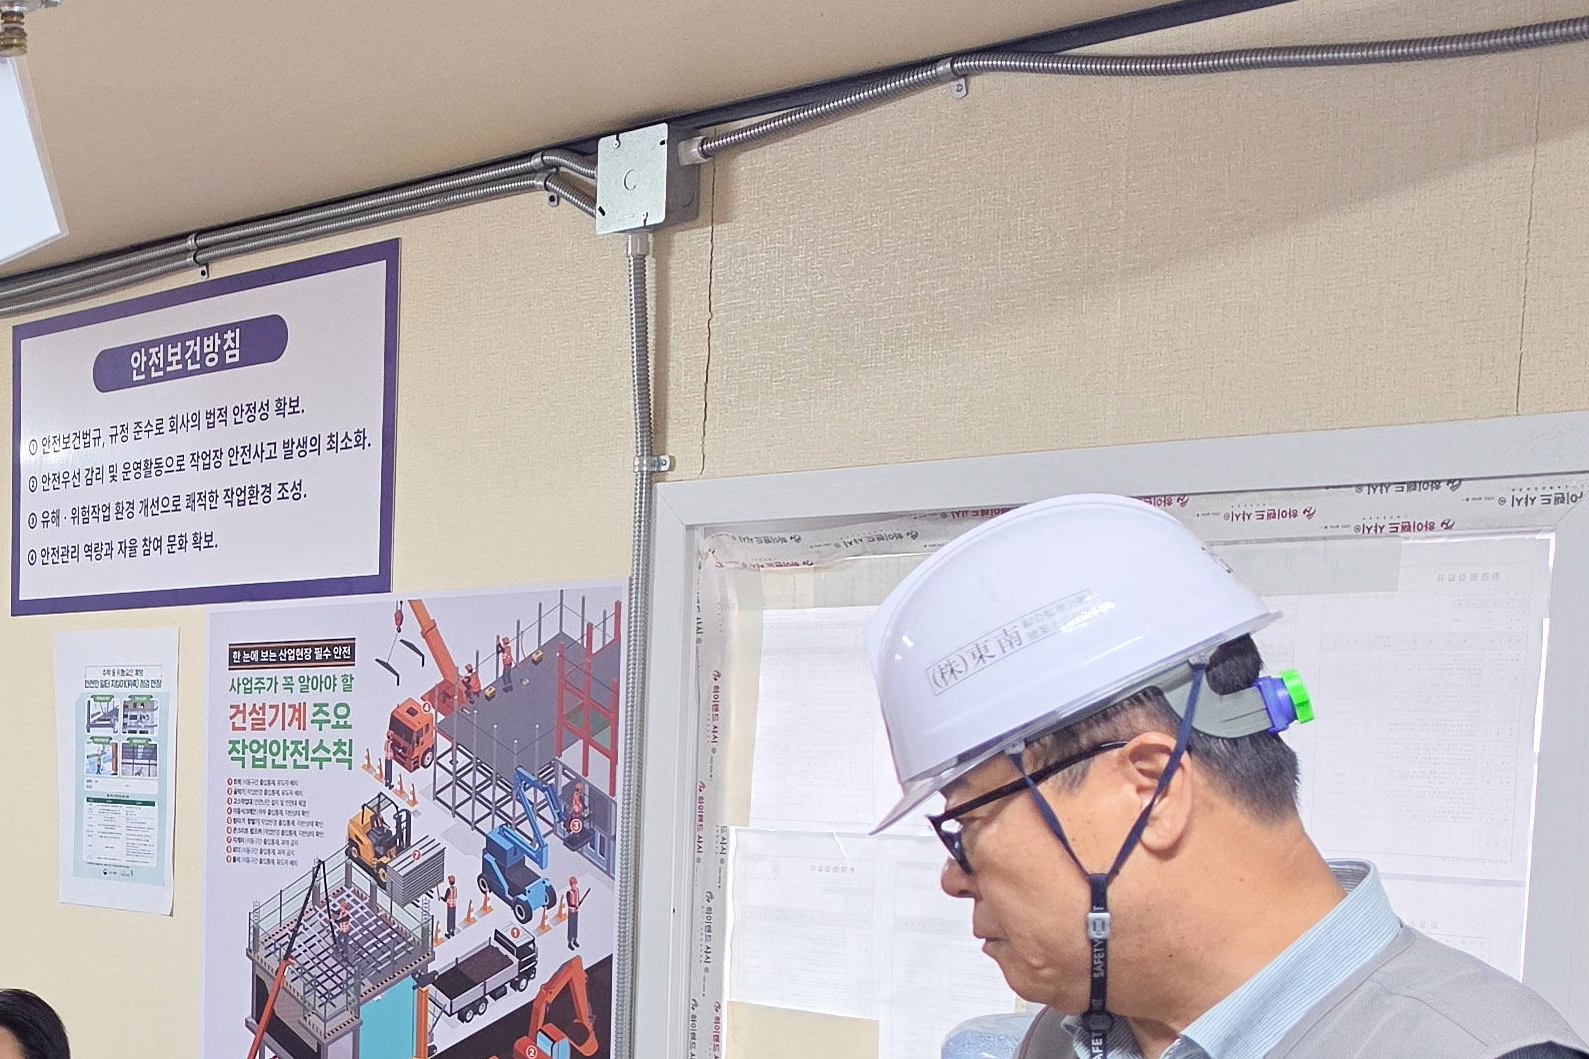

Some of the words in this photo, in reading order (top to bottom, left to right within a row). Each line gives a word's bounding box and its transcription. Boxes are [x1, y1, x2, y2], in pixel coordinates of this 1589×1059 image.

[130, 329, 240, 381] 안전보건방침
[41, 428, 105, 455] 안전보건법규,
[109, 425, 130, 444] 규정
[133, 418, 165, 441] 준수로
[168, 411, 201, 434] 회사의
[205, 405, 228, 427] 법적
[232, 398, 270, 423] 안정성
[274, 395, 305, 416] 확보.
[41, 467, 81, 492] 안전우선
[84, 464, 104, 486] 감리
[108, 462, 118, 484] 및
[121, 453, 186, 482] 운영활동으로
[189, 449, 222, 472] 작업장
[227, 441, 277, 468] 안전사고
[282, 436, 321, 459] 발생의
[326, 427, 372, 453] 최소화.
[41, 508, 61, 528] 유해
[70, 503, 111, 526] 위험작업
[115, 499, 135, 522] 환경
[139, 493, 182, 518] 개선으로
[185, 489, 219, 514] 쾌적한
[223, 479, 272, 508] 작업환경
[277, 479, 307, 502] 조성.
[40, 542, 79, 566] 안전관리
[83, 539, 114, 562] 역량과
[117, 538, 138, 559] 자율
[142, 535, 163, 557] 참여
[167, 532, 188, 555] 문화
[191, 530, 218, 551] 확보.
[233, 650, 241, 663] 한
[242, 650, 259, 663] 눈에
[260, 649, 277, 662] 보는
[279, 648, 312, 661] 산업현장
[314, 647, 331, 660] 필수
[333, 646, 351, 659] 안전
[229, 676, 278, 694] 사업주가
[282, 676, 294, 694] 꼭
[298, 675, 337, 693] 알아야
[342, 674, 354, 692] 할
[229, 702, 307, 732] 건설기계
[311, 702, 353, 731] 주요
[228, 739, 353, 770] 작업안전수칙
[1094, 939, 1104, 978] SAFETY
